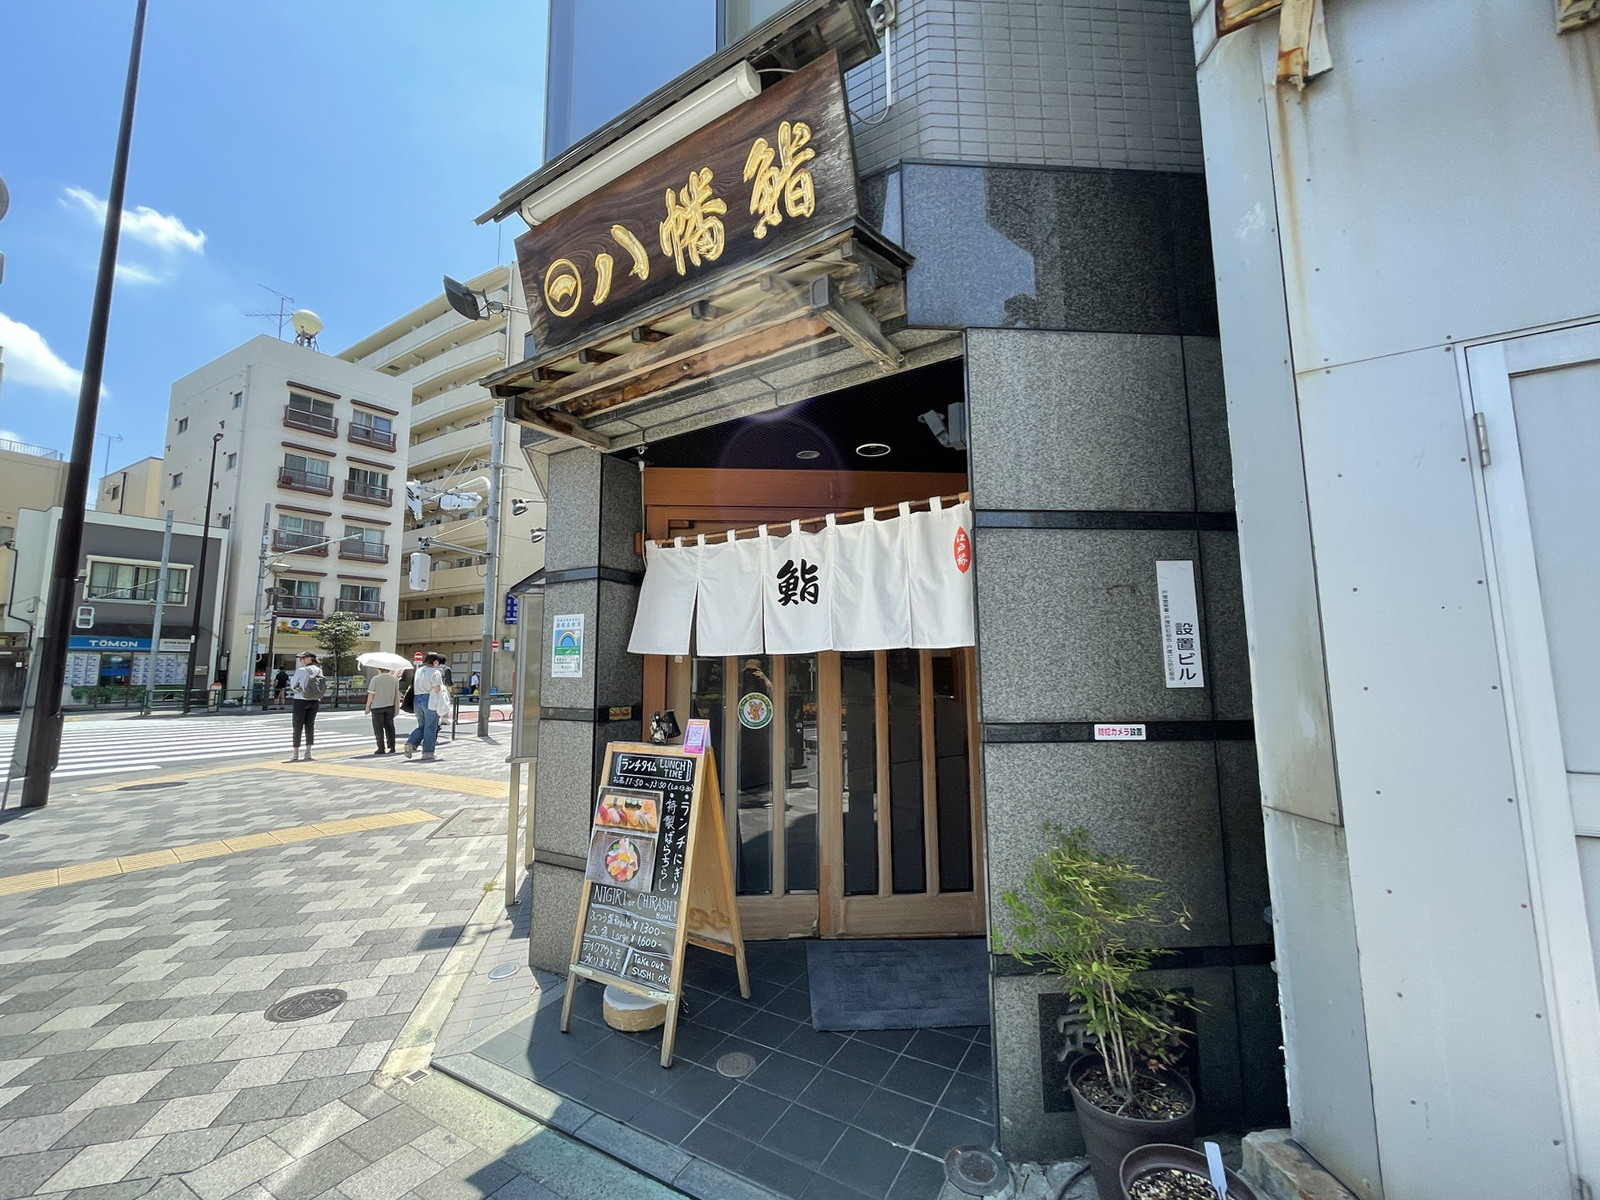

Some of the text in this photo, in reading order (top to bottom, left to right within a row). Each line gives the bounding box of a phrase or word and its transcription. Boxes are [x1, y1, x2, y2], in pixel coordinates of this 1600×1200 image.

[776, 558, 820, 606] 鮨
[89, 639, 138, 648] TOMON
[1175, 622, 1197, 681] 設置ビル
[1097, 727, 1143, 737] 防犯カメラ設置
[621, 758, 657, 772] ランチタイム
[660, 758, 686, 772] LUNCH
[593, 884, 627, 907] NIGIRI
[637, 892, 678, 917] CHIRASHI
[631, 966, 655, 981] SUSHI
